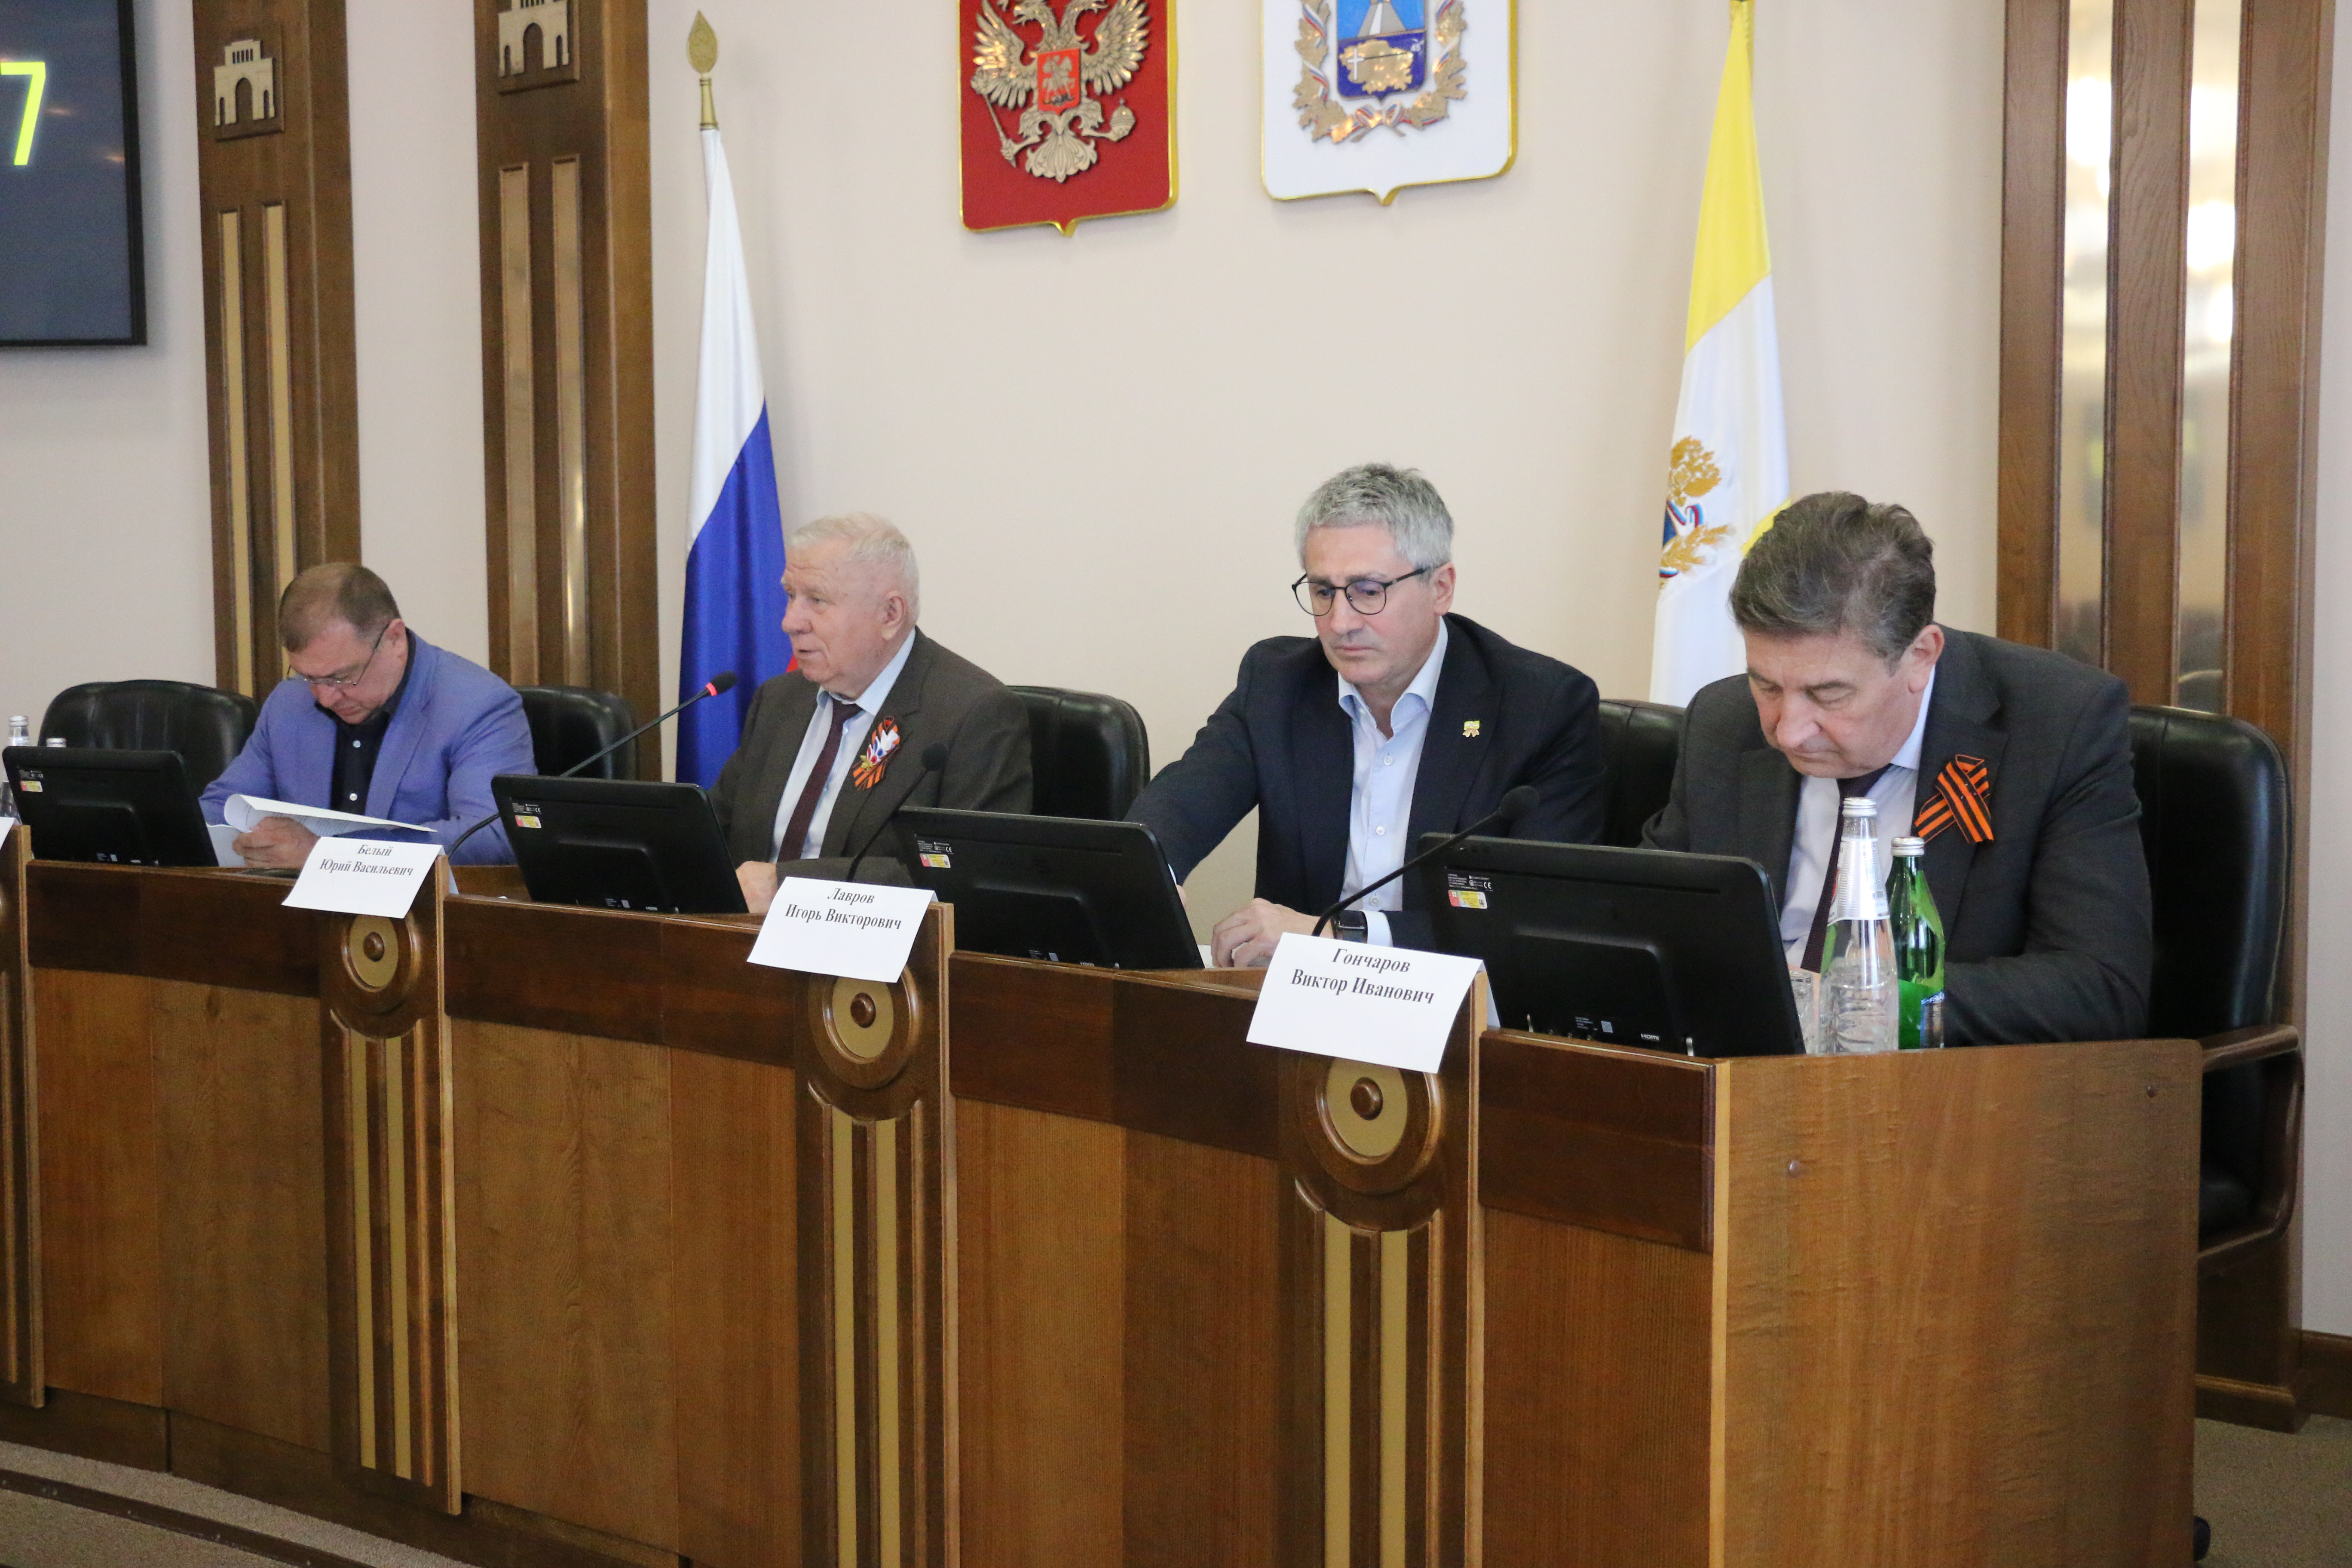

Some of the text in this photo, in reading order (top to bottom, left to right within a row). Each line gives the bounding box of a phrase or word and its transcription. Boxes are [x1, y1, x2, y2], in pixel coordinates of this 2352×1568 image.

[0, 61, 46, 166] 7
[357, 844, 393, 857] Белый
[319, 859, 413, 876] Юрий Васильевич
[827, 888, 875, 906] Лавров
[784, 904, 902, 930] Игорь Викторович
[1331, 948, 1411, 974] Гончаров
[1291, 968, 1435, 1004] Виктор Иванович
